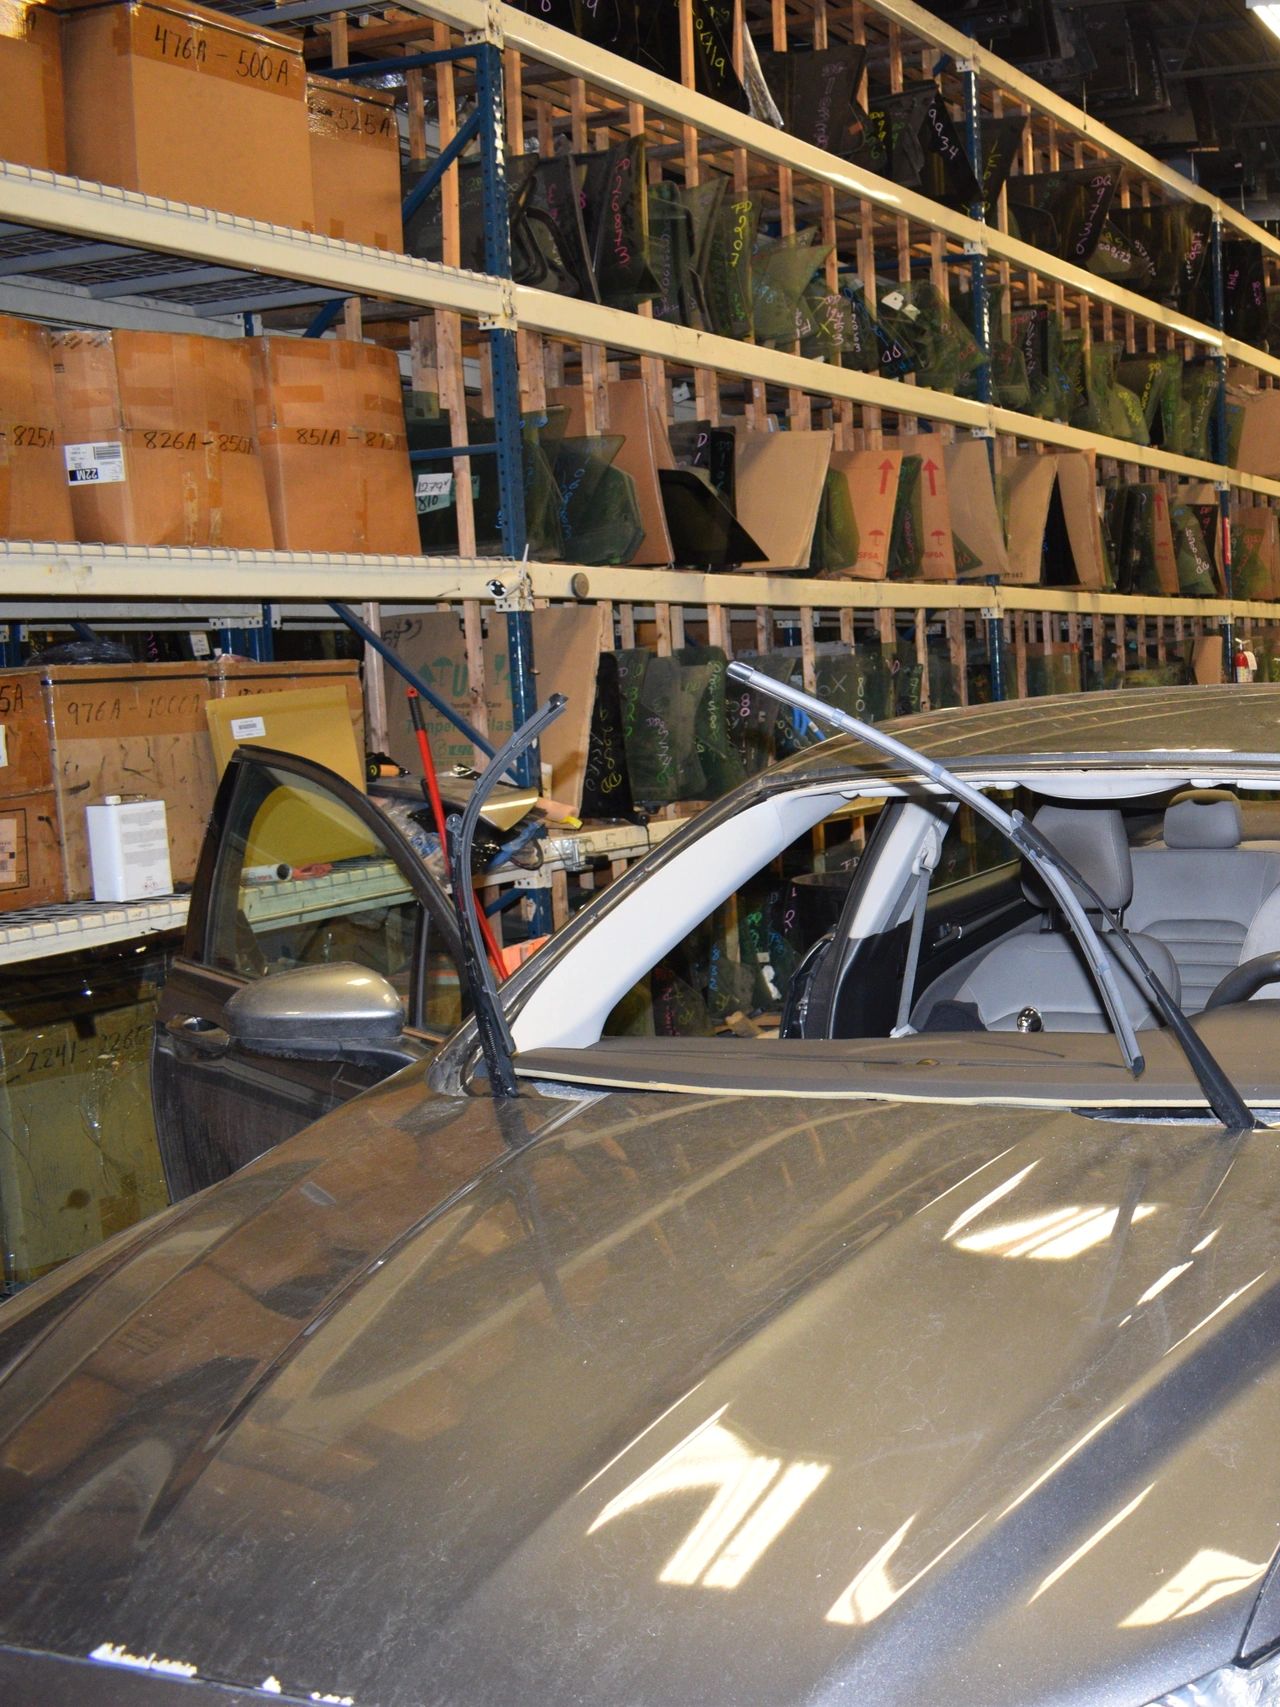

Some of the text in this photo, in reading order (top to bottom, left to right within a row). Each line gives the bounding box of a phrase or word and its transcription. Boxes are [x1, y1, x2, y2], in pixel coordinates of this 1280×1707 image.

[236, 49, 289, 86] 500A
[13, 425, 55, 450] 825A
[143, 431, 198, 450] 826A
[296, 428, 341, 446] 851A
[76, 468, 98, 481] 22M
[67, 698, 121, 724] 976A
